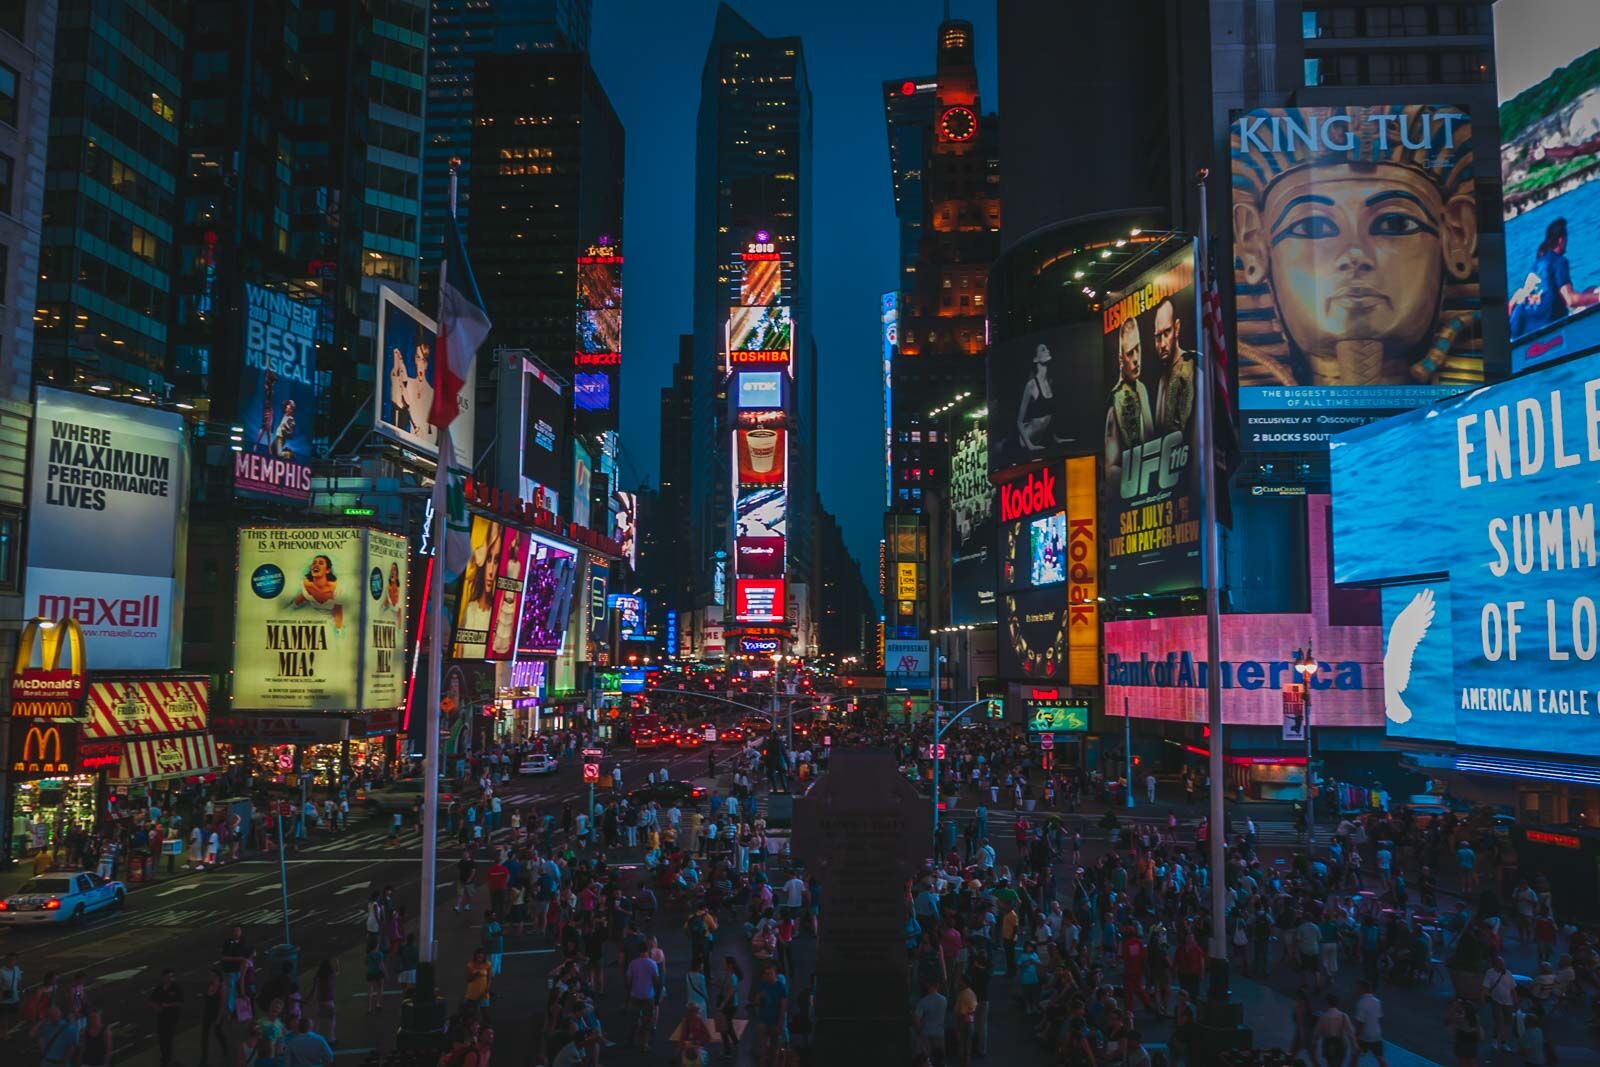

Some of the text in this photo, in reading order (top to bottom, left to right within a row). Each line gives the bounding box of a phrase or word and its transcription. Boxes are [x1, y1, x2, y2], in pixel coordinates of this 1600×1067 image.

[1238, 113, 1462, 153] KING TUT
[748, 243, 775, 253] 2010
[248, 318, 312, 366] BEST
[731, 351, 789, 362] TOSHIBA
[247, 349, 311, 384] MUSICAL
[1262, 388, 1464, 398] THE BIGGEST BLOCKBUSTER EXHIBITION
[1287, 399, 1300, 407] OF
[1303, 399, 1323, 407] ALL
[1326, 399, 1349, 407] TIME
[52, 420, 111, 447] WHERE
[1248, 417, 1299, 425] EXCLUSIVELY
[1253, 433, 1331, 442] 2 BLOCKS SOUT
[50, 438, 169, 480] MAXIMUM
[236, 452, 311, 491] MEMPHIS
[1120, 430, 1189, 499] UFC 116
[48, 464, 168, 498] PERFORMANCE
[1001, 466, 1056, 523] Kodak
[47, 482, 106, 511] LIVES
[1142, 502, 1165, 531] JULY
[258, 540, 267, 549] IS
[268, 540, 277, 549] A
[269, 530, 319, 540] FEEL-GOOD
[322, 530, 361, 539] MUSICAL
[1126, 532, 1138, 555] ON
[1138, 520, 1199, 552] PAY-PER-VIEW
[1488, 503, 1597, 577] SUMM
[1070, 518, 1094, 626] Kodak
[39, 595, 160, 628] maxell
[266, 625, 328, 650] MAMMA
[1481, 596, 1597, 661] OF LO
[742, 641, 778, 650] YAHOO
[278, 651, 315, 677] MIA!
[1107, 650, 1362, 690] Bank of America
[13, 680, 81, 690] McDonald's
[1461, 687, 1590, 715] AMERICAN EAGLE
